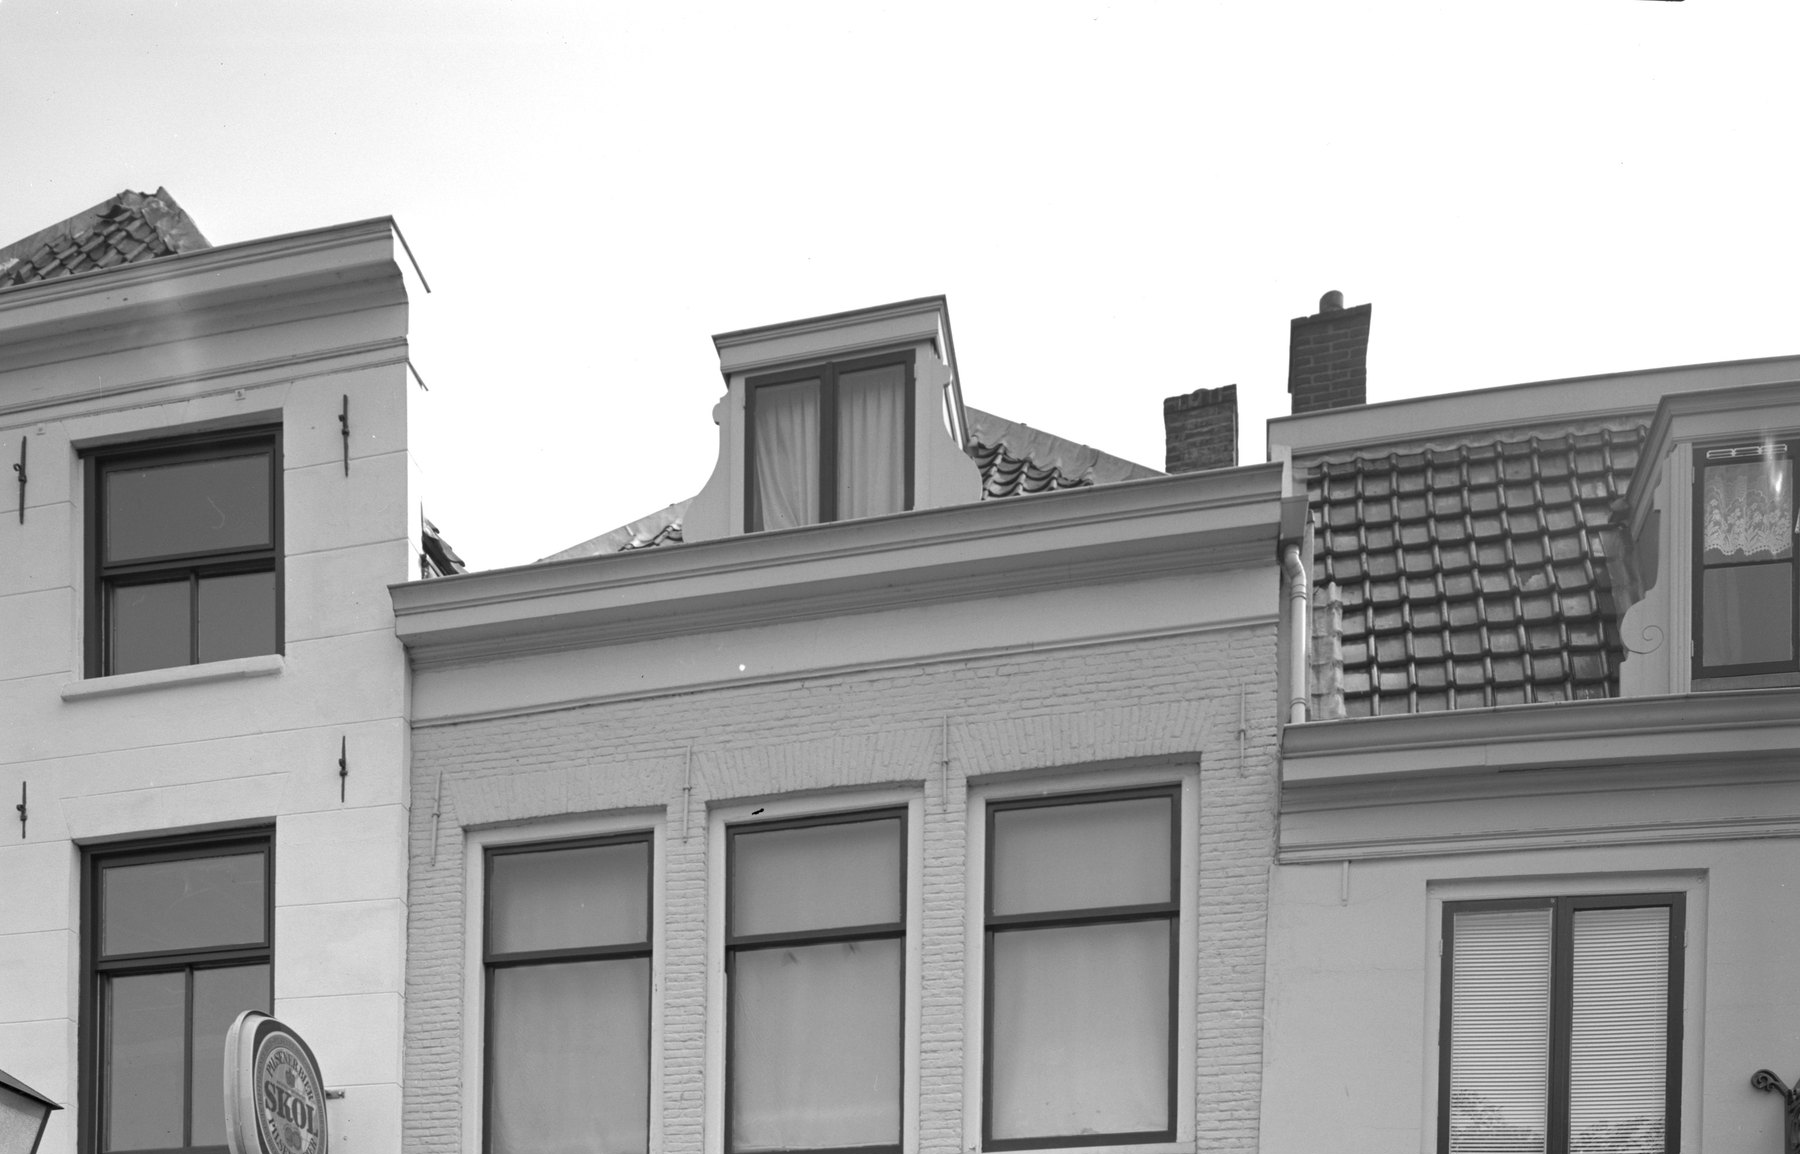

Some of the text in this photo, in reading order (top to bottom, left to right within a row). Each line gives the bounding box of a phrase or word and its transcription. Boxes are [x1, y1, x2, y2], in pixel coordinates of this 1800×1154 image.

[266, 1051, 315, 1100] PILSENER BIER
[264, 1080, 318, 1138] SKOL
